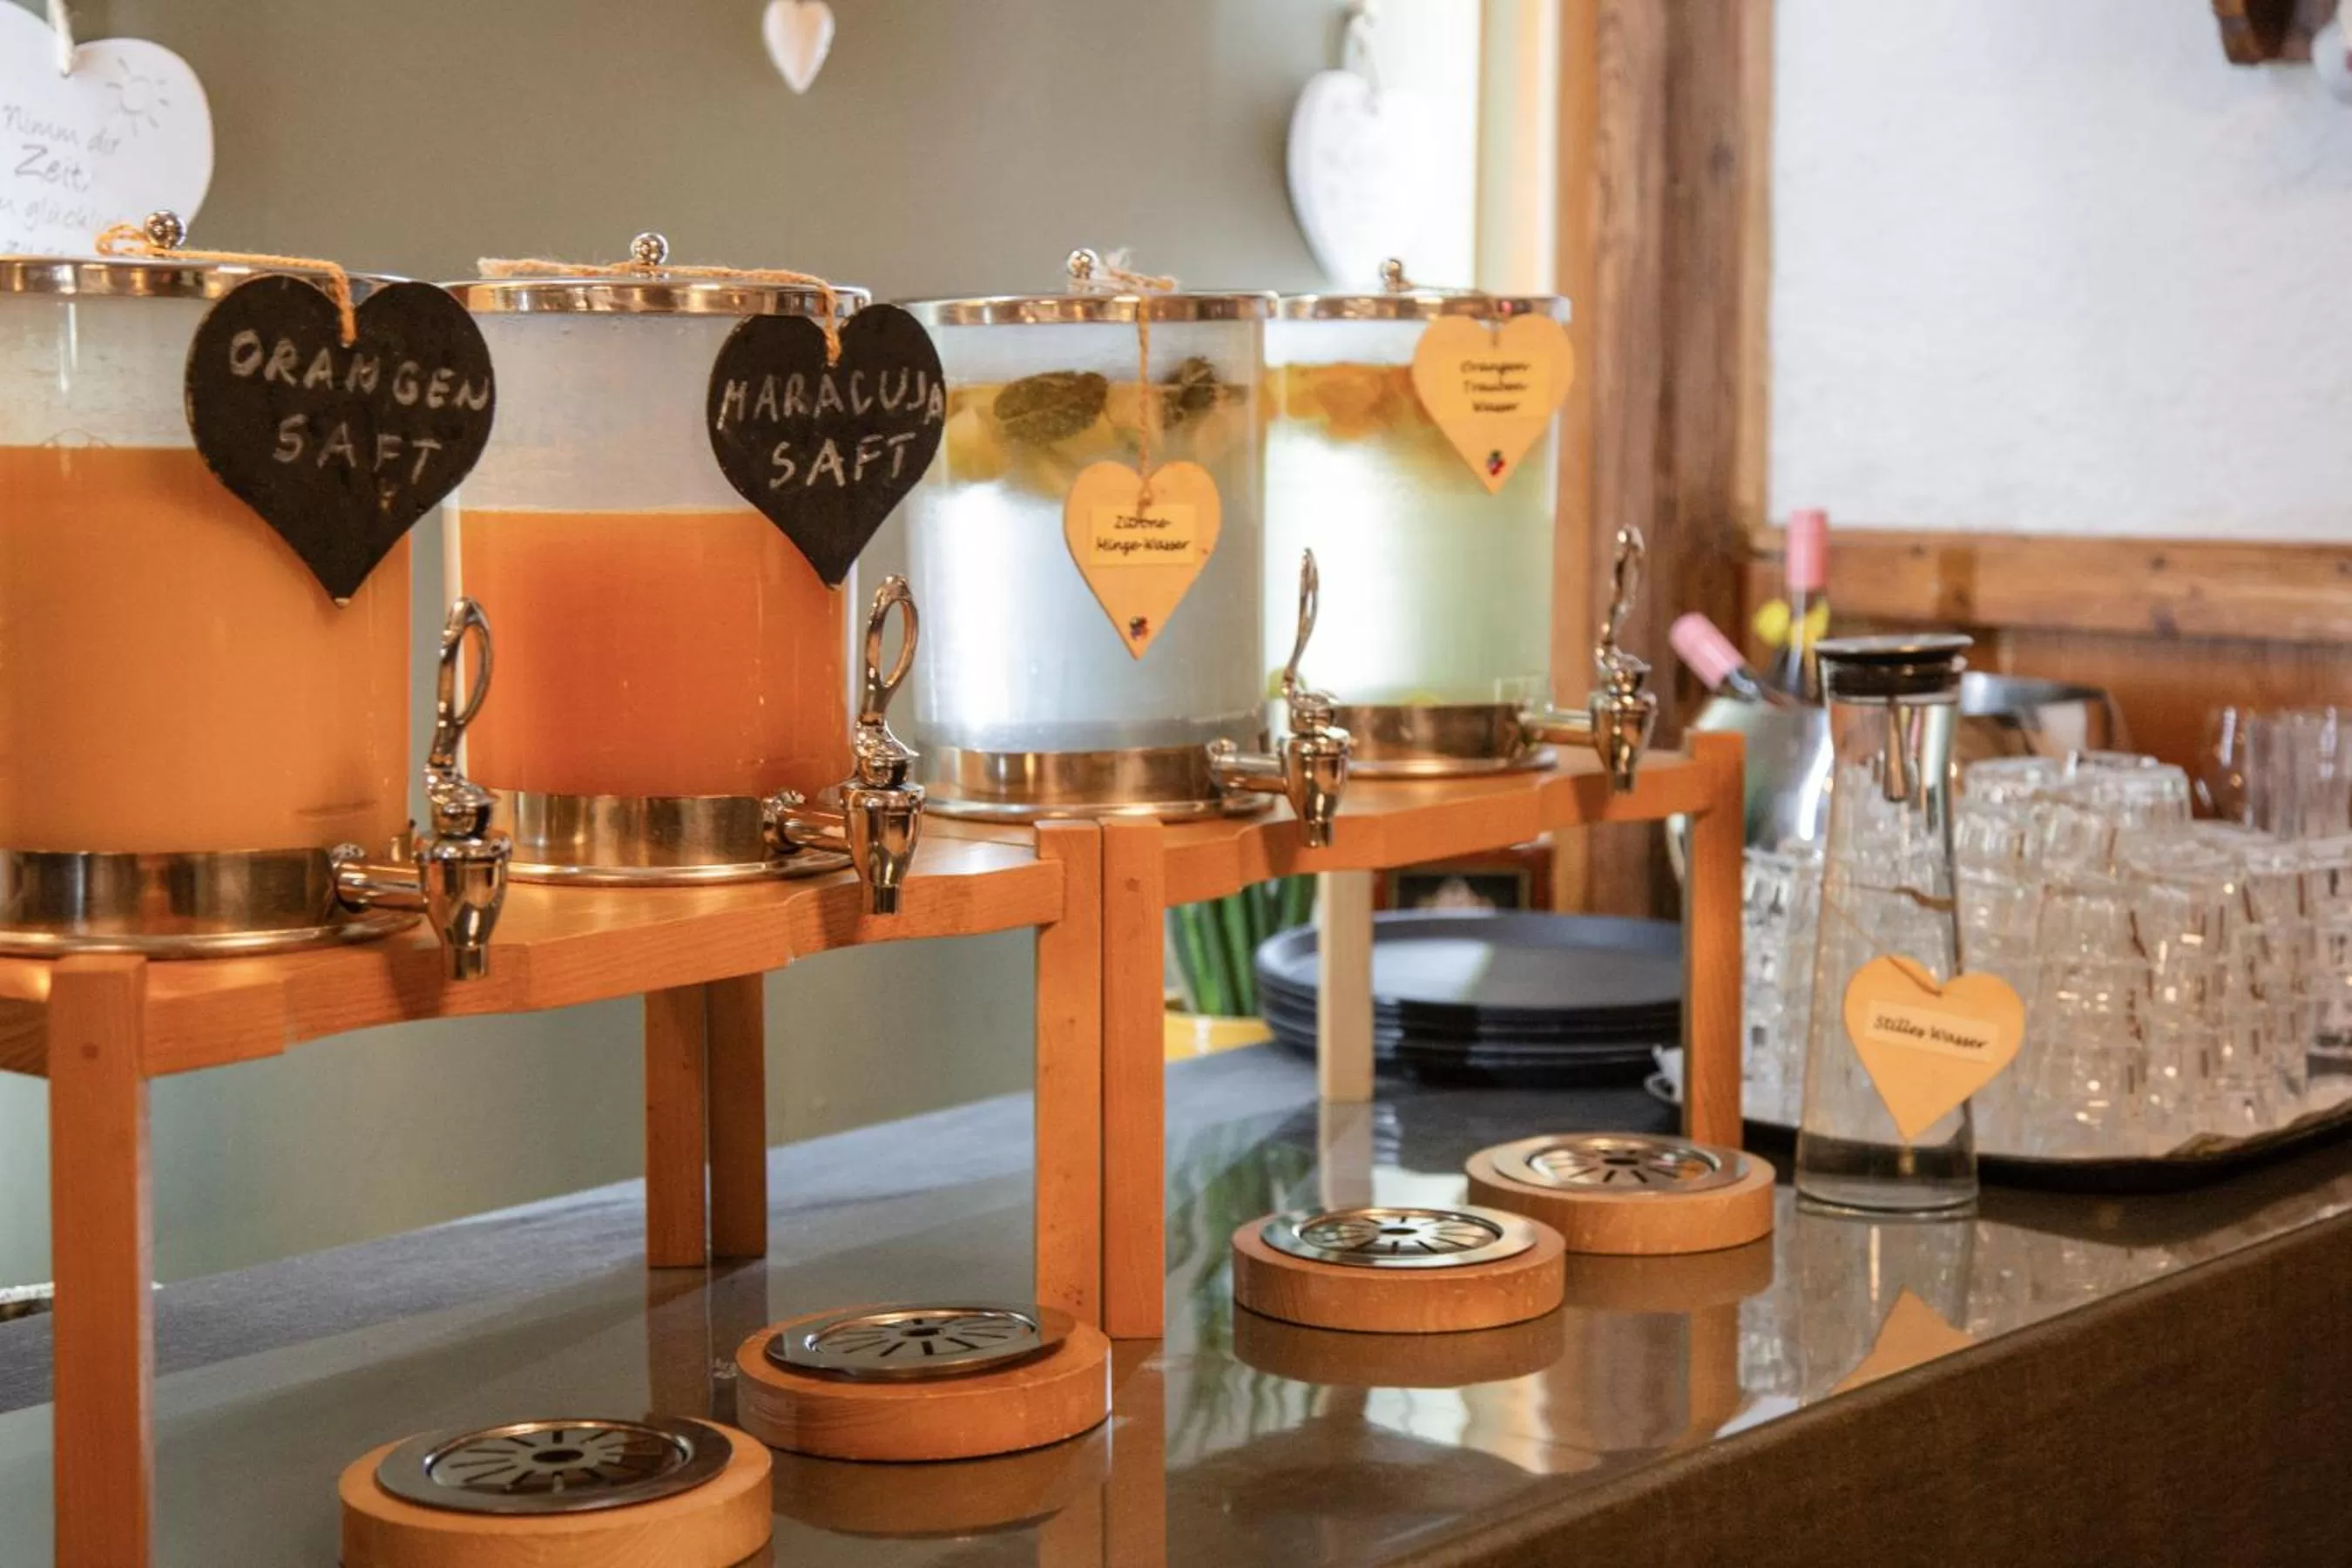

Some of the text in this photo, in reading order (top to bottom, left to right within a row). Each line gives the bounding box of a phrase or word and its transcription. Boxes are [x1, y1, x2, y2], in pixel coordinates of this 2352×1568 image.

[229, 328, 490, 411] ORANGEN
[716, 366, 944, 431] MARACUJA
[272, 413, 443, 485] SAFT
[769, 432, 916, 489] SAFT
[1930, 1024, 1990, 1050] Wasser
